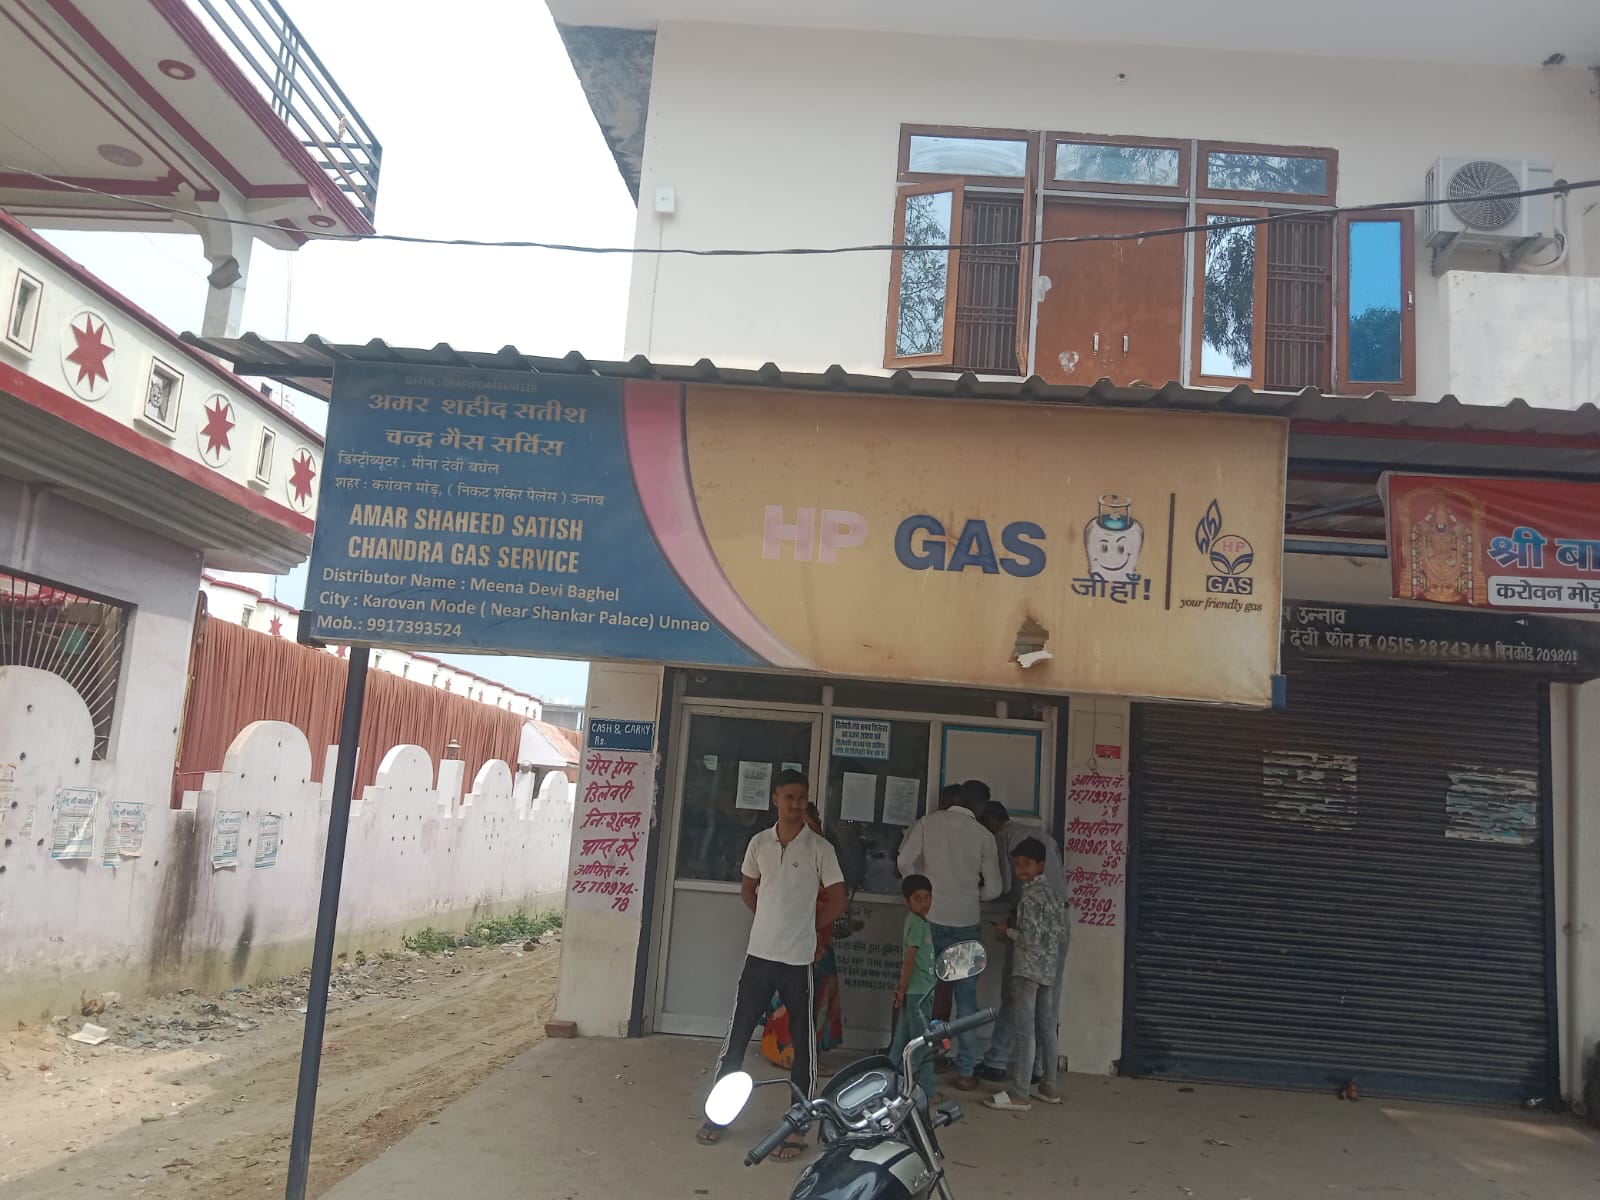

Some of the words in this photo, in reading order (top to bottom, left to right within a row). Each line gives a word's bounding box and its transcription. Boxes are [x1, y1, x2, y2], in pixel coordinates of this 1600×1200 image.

[368, 393, 429, 413] अमर
[440, 394, 508, 419] शहीद
[514, 399, 588, 424] सतीश
[385, 428, 434, 449] चन्द्र
[440, 427, 486, 452] गैस
[492, 432, 565, 457] सर्विस
[411, 455, 438, 470] मीना
[441, 456, 465, 472] देवी
[468, 460, 500, 475] बघेल
[335, 477, 361, 489] शहर
[458, 482, 491, 498] निकट
[493, 484, 524, 501] शंकर
[526, 486, 558, 502] पैलेस
[570, 493, 605, 507] उन्नाव
[348, 504, 408, 529] AMAR
[414, 511, 505, 536] SHAHEED
[511, 515, 584, 542] SATISH
[761, 505, 869, 563] HP
[894, 513, 1047, 578] GAS
[1221, 541, 1246, 553] HP
[1486, 526, 1547, 569] श्री
[347, 535, 445, 564] CHANDRA
[450, 542, 491, 567] GAS
[497, 546, 580, 574] SERVICE
[322, 567, 406, 587] Distributor
[410, 574, 456, 590] Name
[470, 577, 524, 594] Meena
[529, 581, 563, 597] Devi
[567, 585, 620, 603] Baghel
[1071, 571, 1109, 598] जी
[1207, 576, 1251, 594] GAS
[1495, 579, 1563, 601] करोवन
[319, 591, 350, 609] City
[363, 595, 425, 611] Karovan
[430, 598, 476, 615] Mode
[491, 602, 529, 618] Near
[532, 605, 595, 624] Shankar
[599, 611, 655, 631] Palace)
[659, 615, 710, 632] Unnao
[1179, 598, 1204, 609] your
[1203, 597, 1244, 613] friendly
[1243, 603, 1263, 613] gas
[1296, 606, 1347, 625] उन्नाव
[366, 618, 462, 638] 9917393524
[1325, 627, 1354, 649] फोन
[592, 723, 612, 733] CASH
[614, 723, 622, 735] &
[586, 753, 613, 776] गैस
[611, 756, 638, 779] होम
[584, 780, 635, 803] डिलेवरी
[580, 838, 619, 859] प्राप्त
[611, 897, 630, 912] 78
[1078, 912, 1116, 926] 2222
